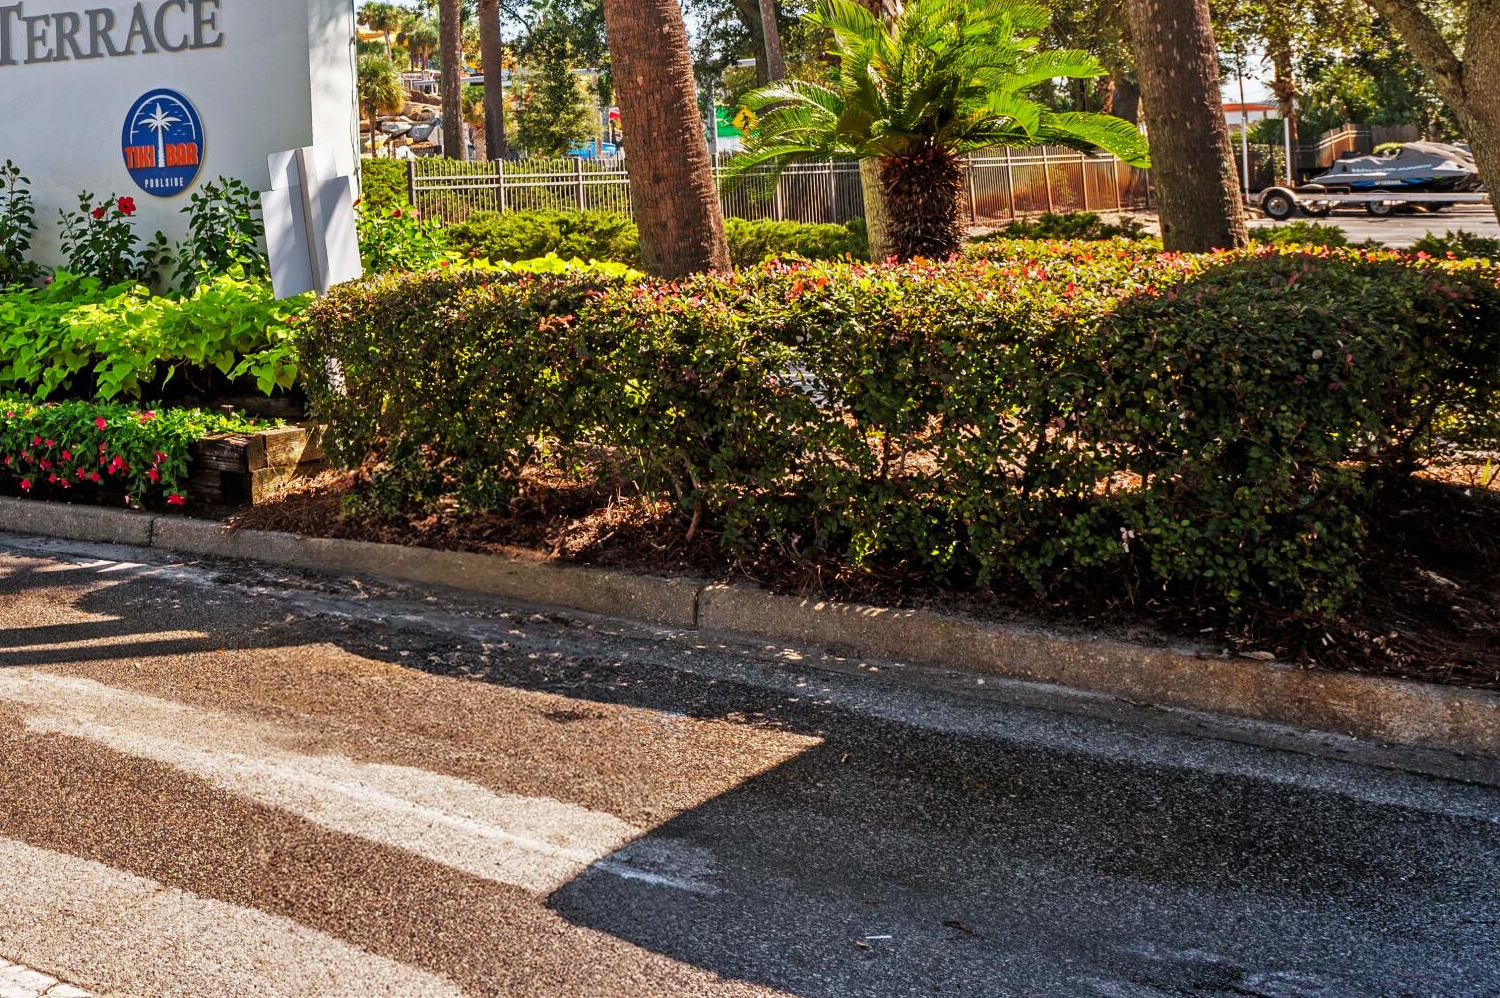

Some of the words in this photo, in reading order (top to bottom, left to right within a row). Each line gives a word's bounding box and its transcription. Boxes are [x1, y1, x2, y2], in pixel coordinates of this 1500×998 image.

[124, 145, 156, 170] TIKI
[165, 142, 199, 168] BAR
[144, 177, 184, 188] POOLSIDE
